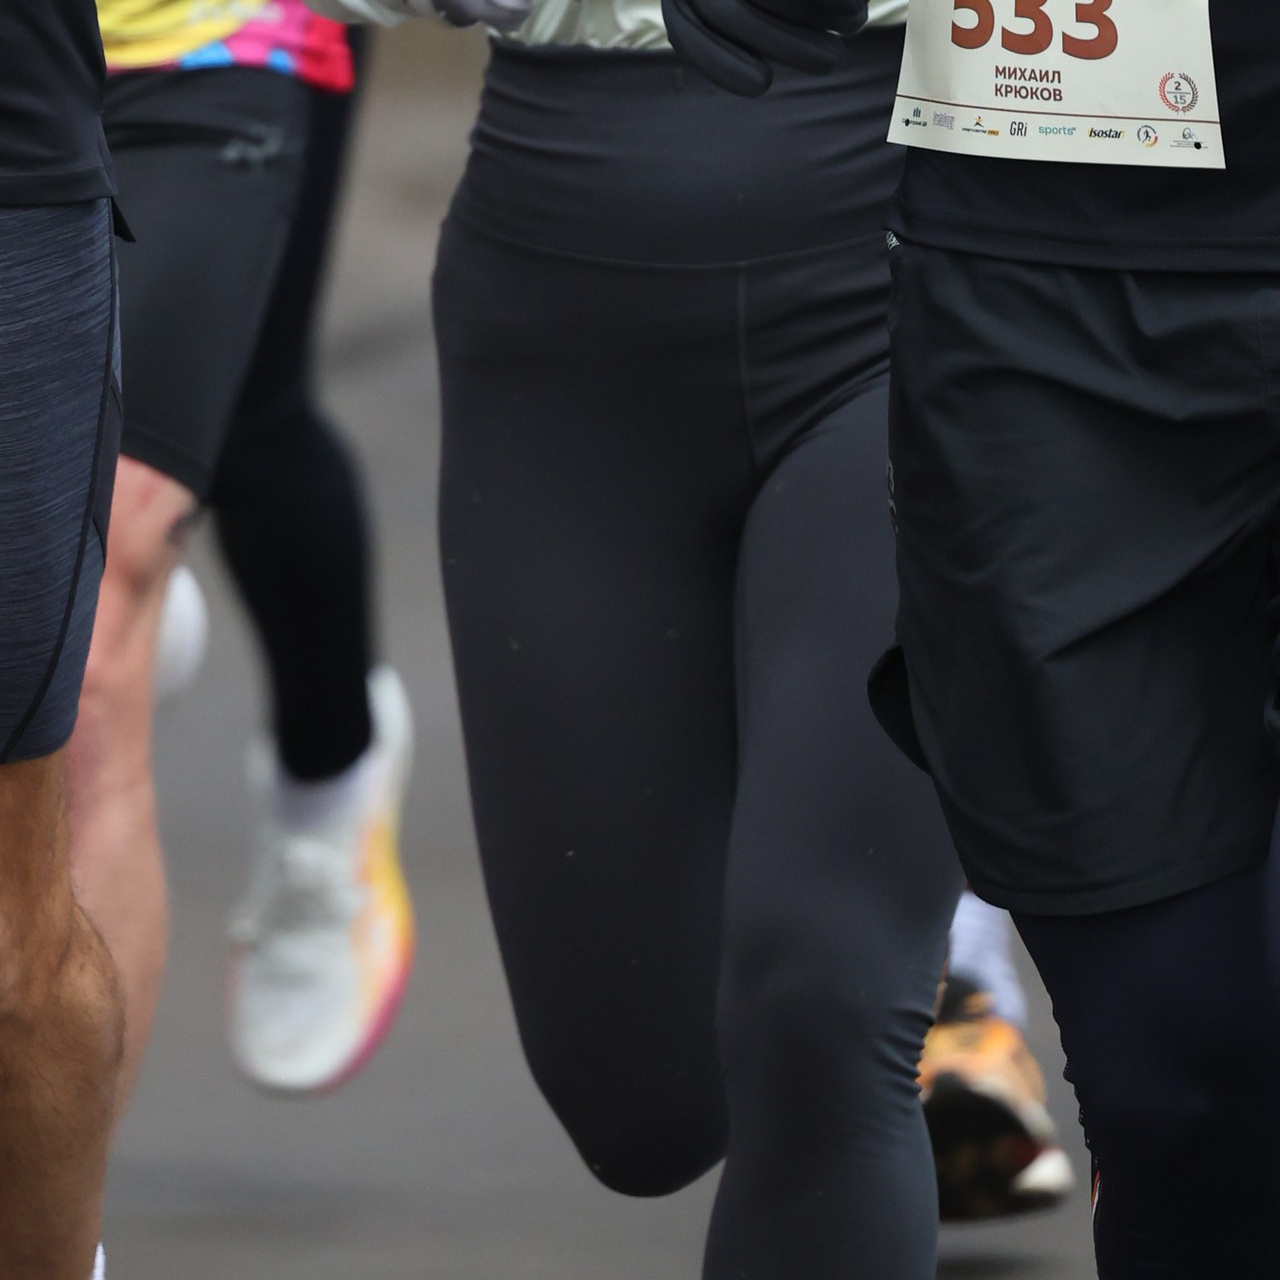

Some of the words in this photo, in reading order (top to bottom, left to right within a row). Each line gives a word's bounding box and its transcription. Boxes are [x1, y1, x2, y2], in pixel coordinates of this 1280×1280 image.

[994, 64, 1062, 84] МИХАИЛ
[994, 83, 1063, 102] КРЮКОВ
[1173, 81, 1183, 91] 2
[1172, 94, 1187, 105] 15
[1009, 120, 1028, 137] GRi
